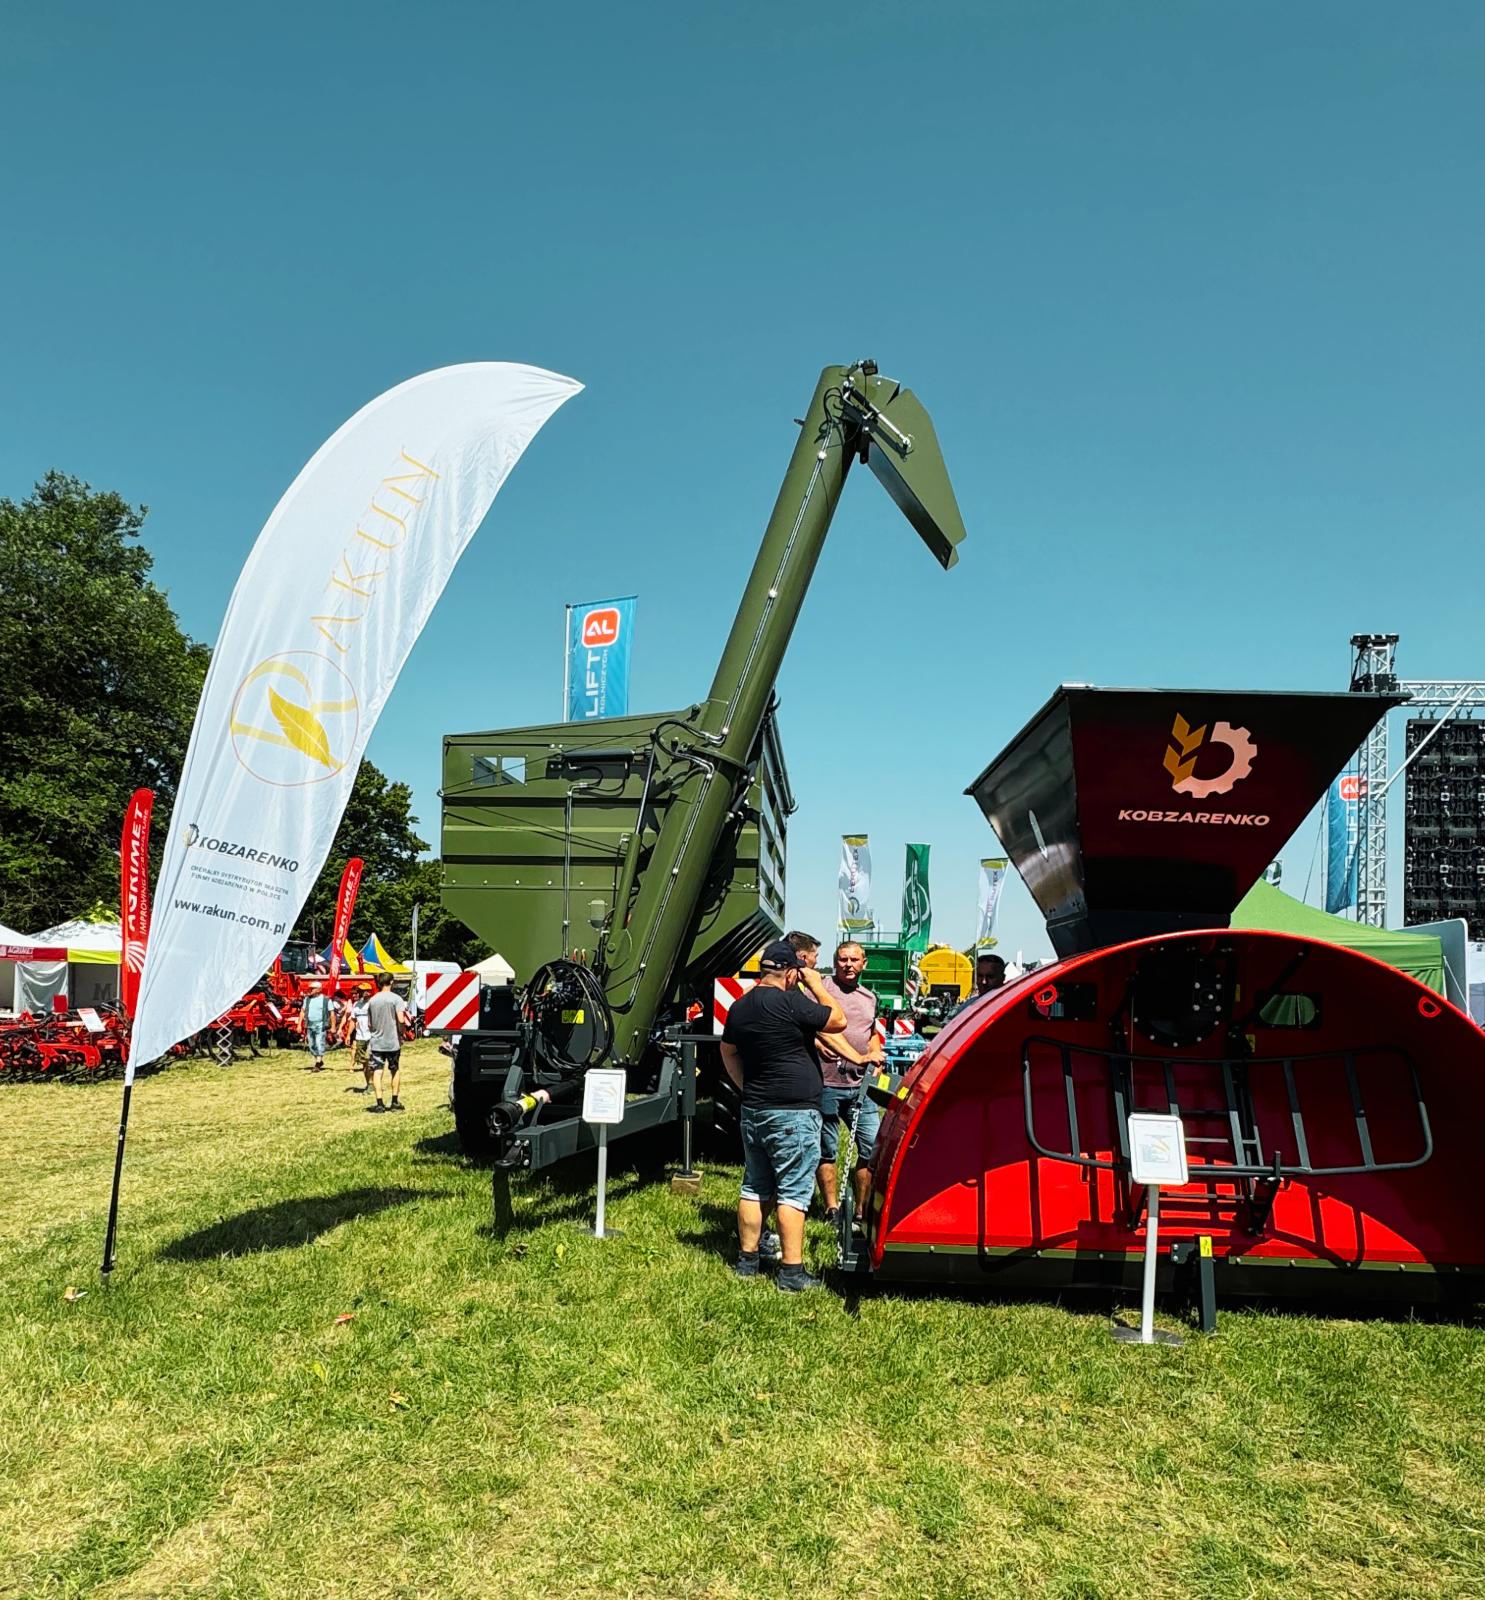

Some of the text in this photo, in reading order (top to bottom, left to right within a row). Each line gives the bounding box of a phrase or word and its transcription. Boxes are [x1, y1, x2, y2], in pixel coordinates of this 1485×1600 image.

[586, 619, 615, 637] AL
[1118, 809, 1270, 826] KOBZARENKO
[128, 802, 143, 932] AGRIMET
[199, 836, 299, 873] KOBZARENKO
[139, 878, 147, 935] IMPROVING
[174, 899, 286, 935] www.rakun.com.pl
[336, 866, 356, 951] AGRIMET
